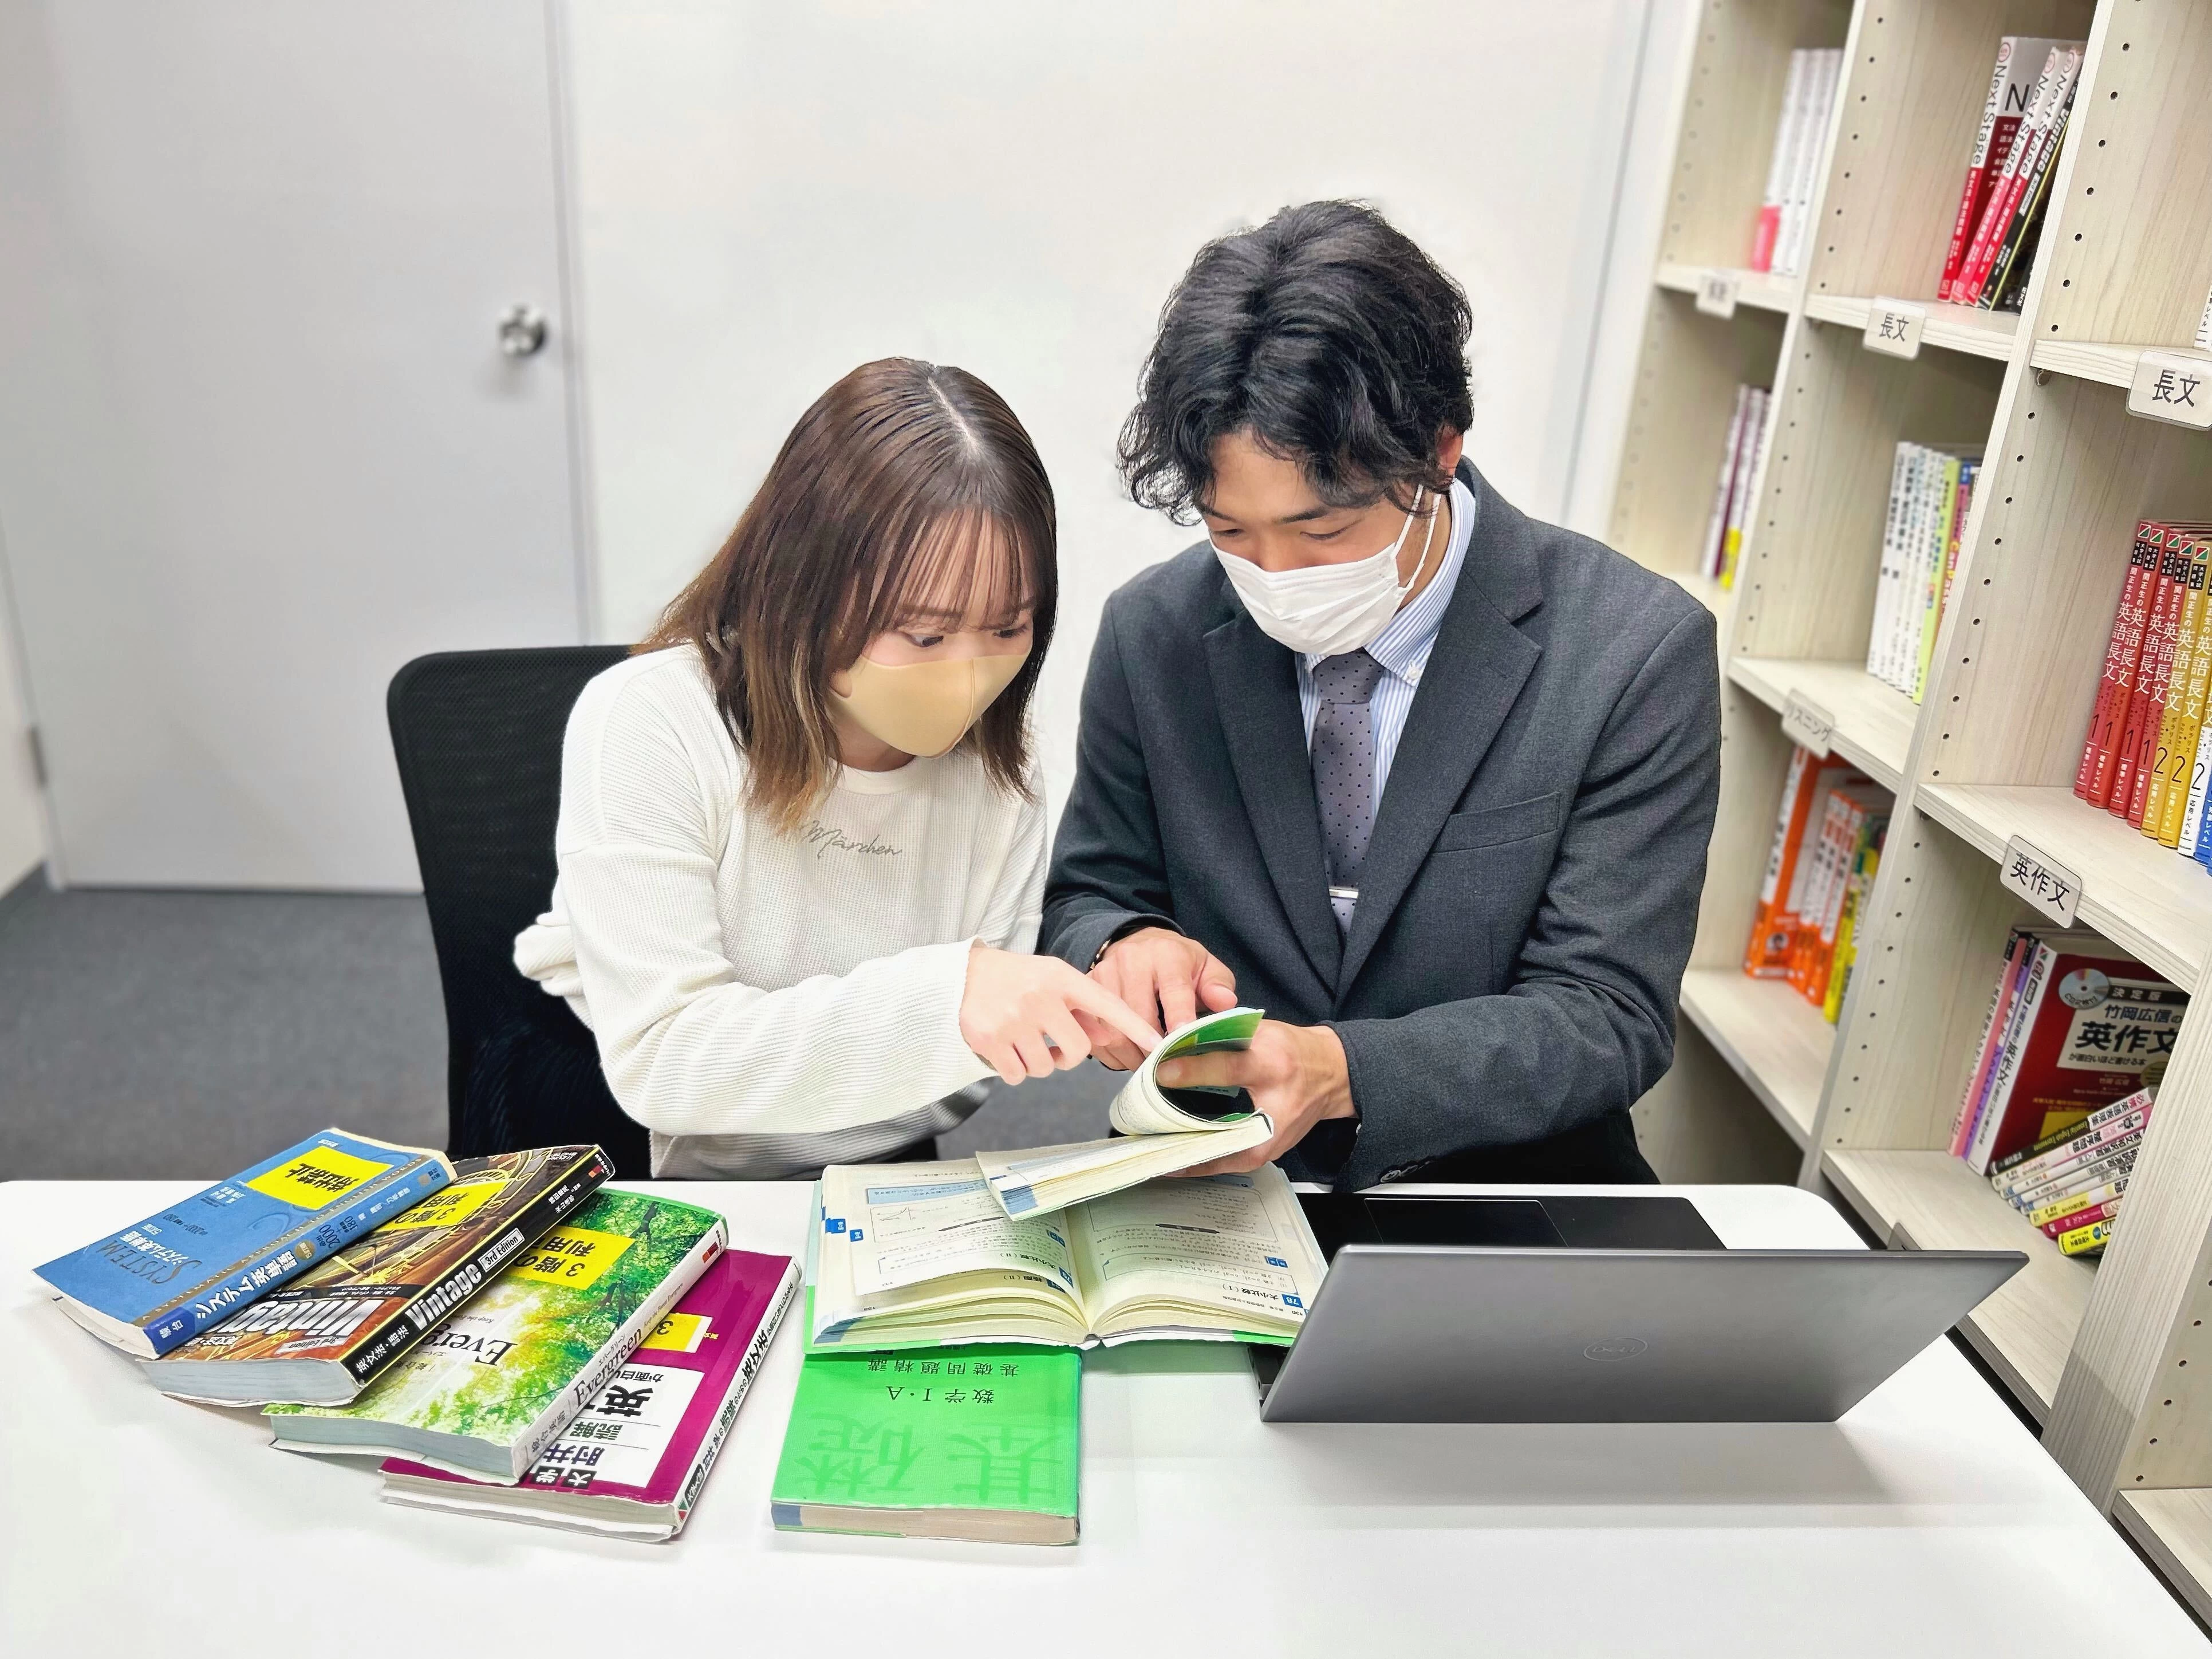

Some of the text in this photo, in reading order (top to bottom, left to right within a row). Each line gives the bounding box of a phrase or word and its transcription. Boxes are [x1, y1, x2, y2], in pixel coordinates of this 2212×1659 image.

[2027, 75, 2049, 119] Next
[2045, 74, 2068, 119] Next
[1973, 65, 2008, 165] Next Stage
[2005, 120, 2030, 174] Stage
[2022, 120, 2048, 174] Stage
[1879, 312, 1909, 342] 長文
[2152, 369, 2201, 407] 長文
[1786, 706, 1832, 742] リスニング
[2092, 714, 2099, 738] 1
[2105, 722, 2113, 746] 1
[2127, 729, 2134, 754] 1
[2143, 739, 2150, 765] 1
[2154, 747, 2168, 774] 2
[2171, 755, 2186, 783] 2
[2191, 763, 2205, 791] 2
[2010, 853, 2070, 911] 英作文
[2104, 1004, 2183, 1024] 竹岡広信の
[2075, 1021, 2181, 1054] 英作文
[2068, 1053, 2147, 1066] が面白いほど書ける本
[285, 1163, 360, 1193] 持出禁止
[153, 1266, 235, 1313] SYSTEMATIC
[382, 1157, 421, 1181] WORDS
[318, 1224, 341, 1248] 2000
[344, 1216, 358, 1231] 180
[96, 1240, 203, 1284] SYSTEM
[120, 1231, 189, 1265] システム英単語
[484, 1235, 519, 1266] 3rd Edition
[514, 1254, 585, 1277] 3階の
[196, 1250, 298, 1319] システム英単語
[405, 1264, 482, 1330] Vintage
[1286, 1296, 1299, 1305] 78
[159, 1319, 184, 1339] 駿台
[198, 1299, 385, 1336] Vintag
[290, 1337, 337, 1350] 3rd Edition
[355, 1325, 410, 1374] 英文法・語法
[420, 1323, 518, 1366] Everg
[598, 1334, 626, 1366] エバーグリーン
[573, 1327, 642, 1409] Evergreen
[868, 1358, 1020, 1378] 基礎問題精講
[531, 1410, 566, 1453] 総合英語
[569, 1421, 623, 1441] 読解
[543, 1443, 605, 1467] 肘井
[535, 1469, 592, 1487] 大学
[688, 1467, 704, 1502] 大学入試
